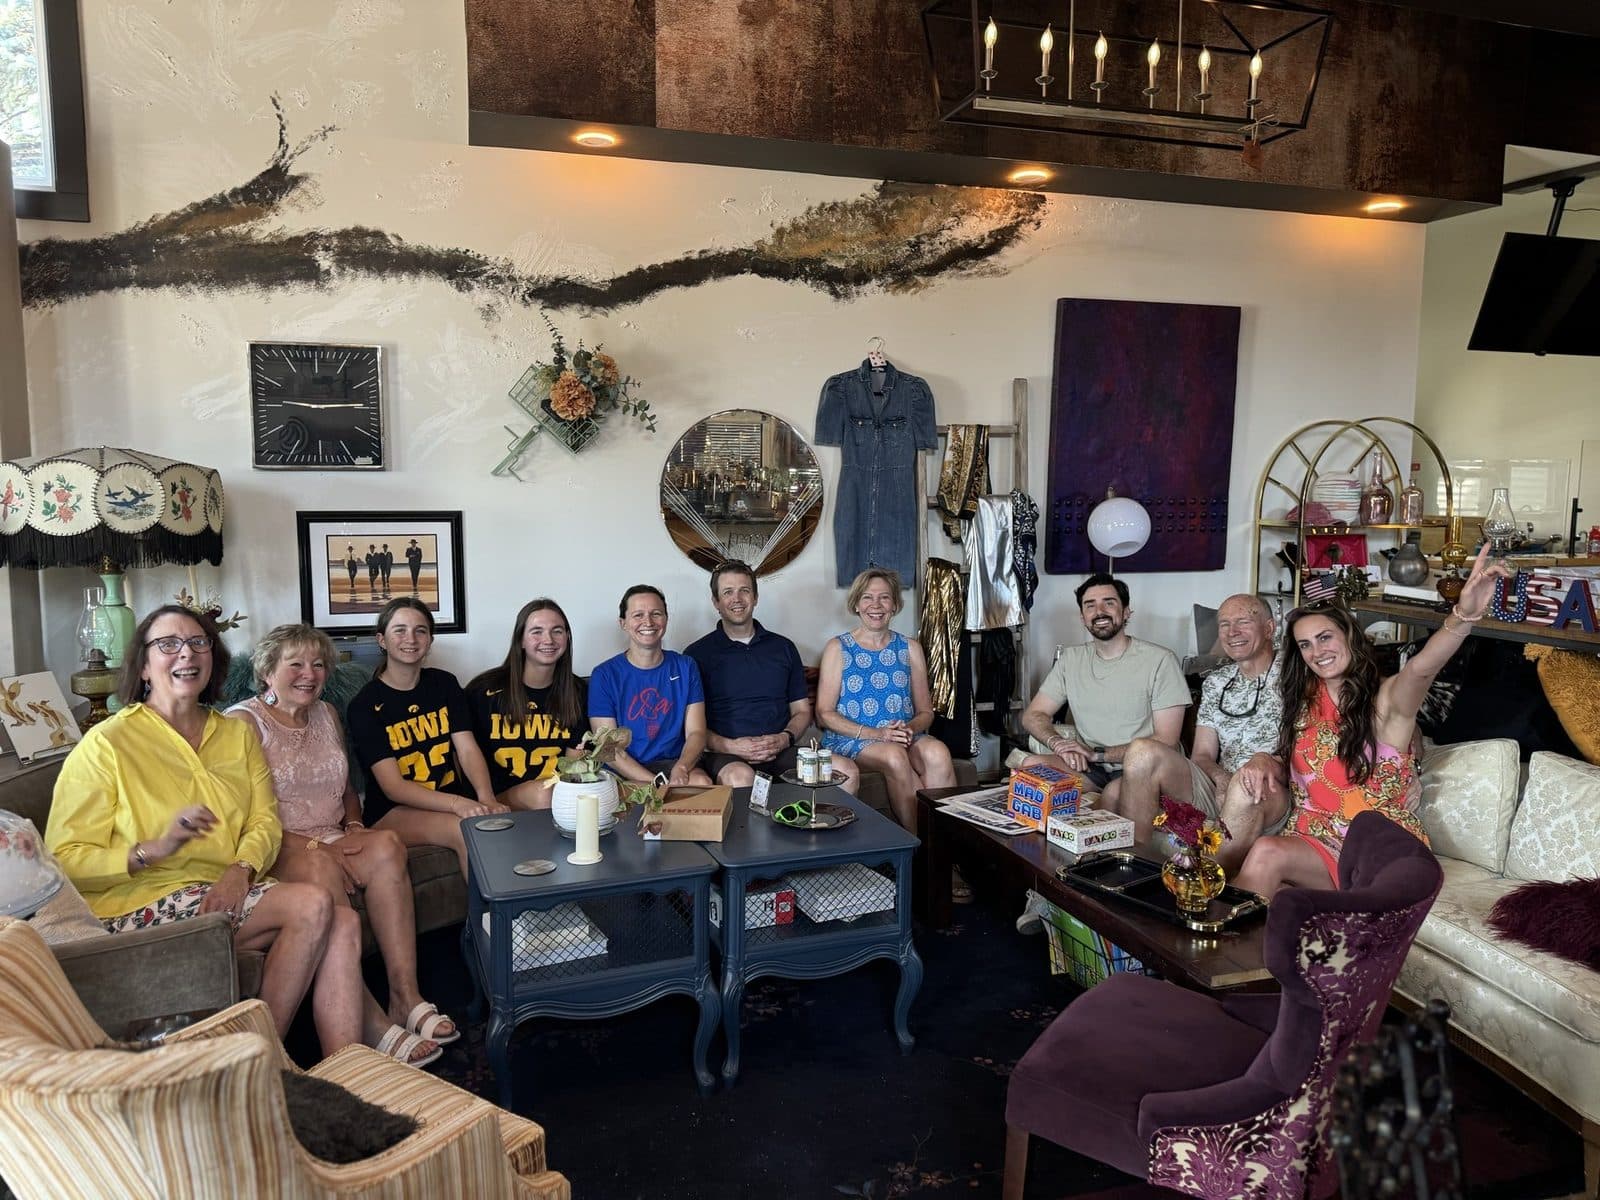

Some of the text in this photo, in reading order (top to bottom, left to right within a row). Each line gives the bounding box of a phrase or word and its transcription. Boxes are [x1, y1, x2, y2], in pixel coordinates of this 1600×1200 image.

[1492, 571, 1600, 633] USA
[490, 713, 570, 740] IOWA
[1013, 781, 1045, 804] MAD
[1052, 788, 1079, 807] MAD
[1012, 797, 1042, 821] GAB
